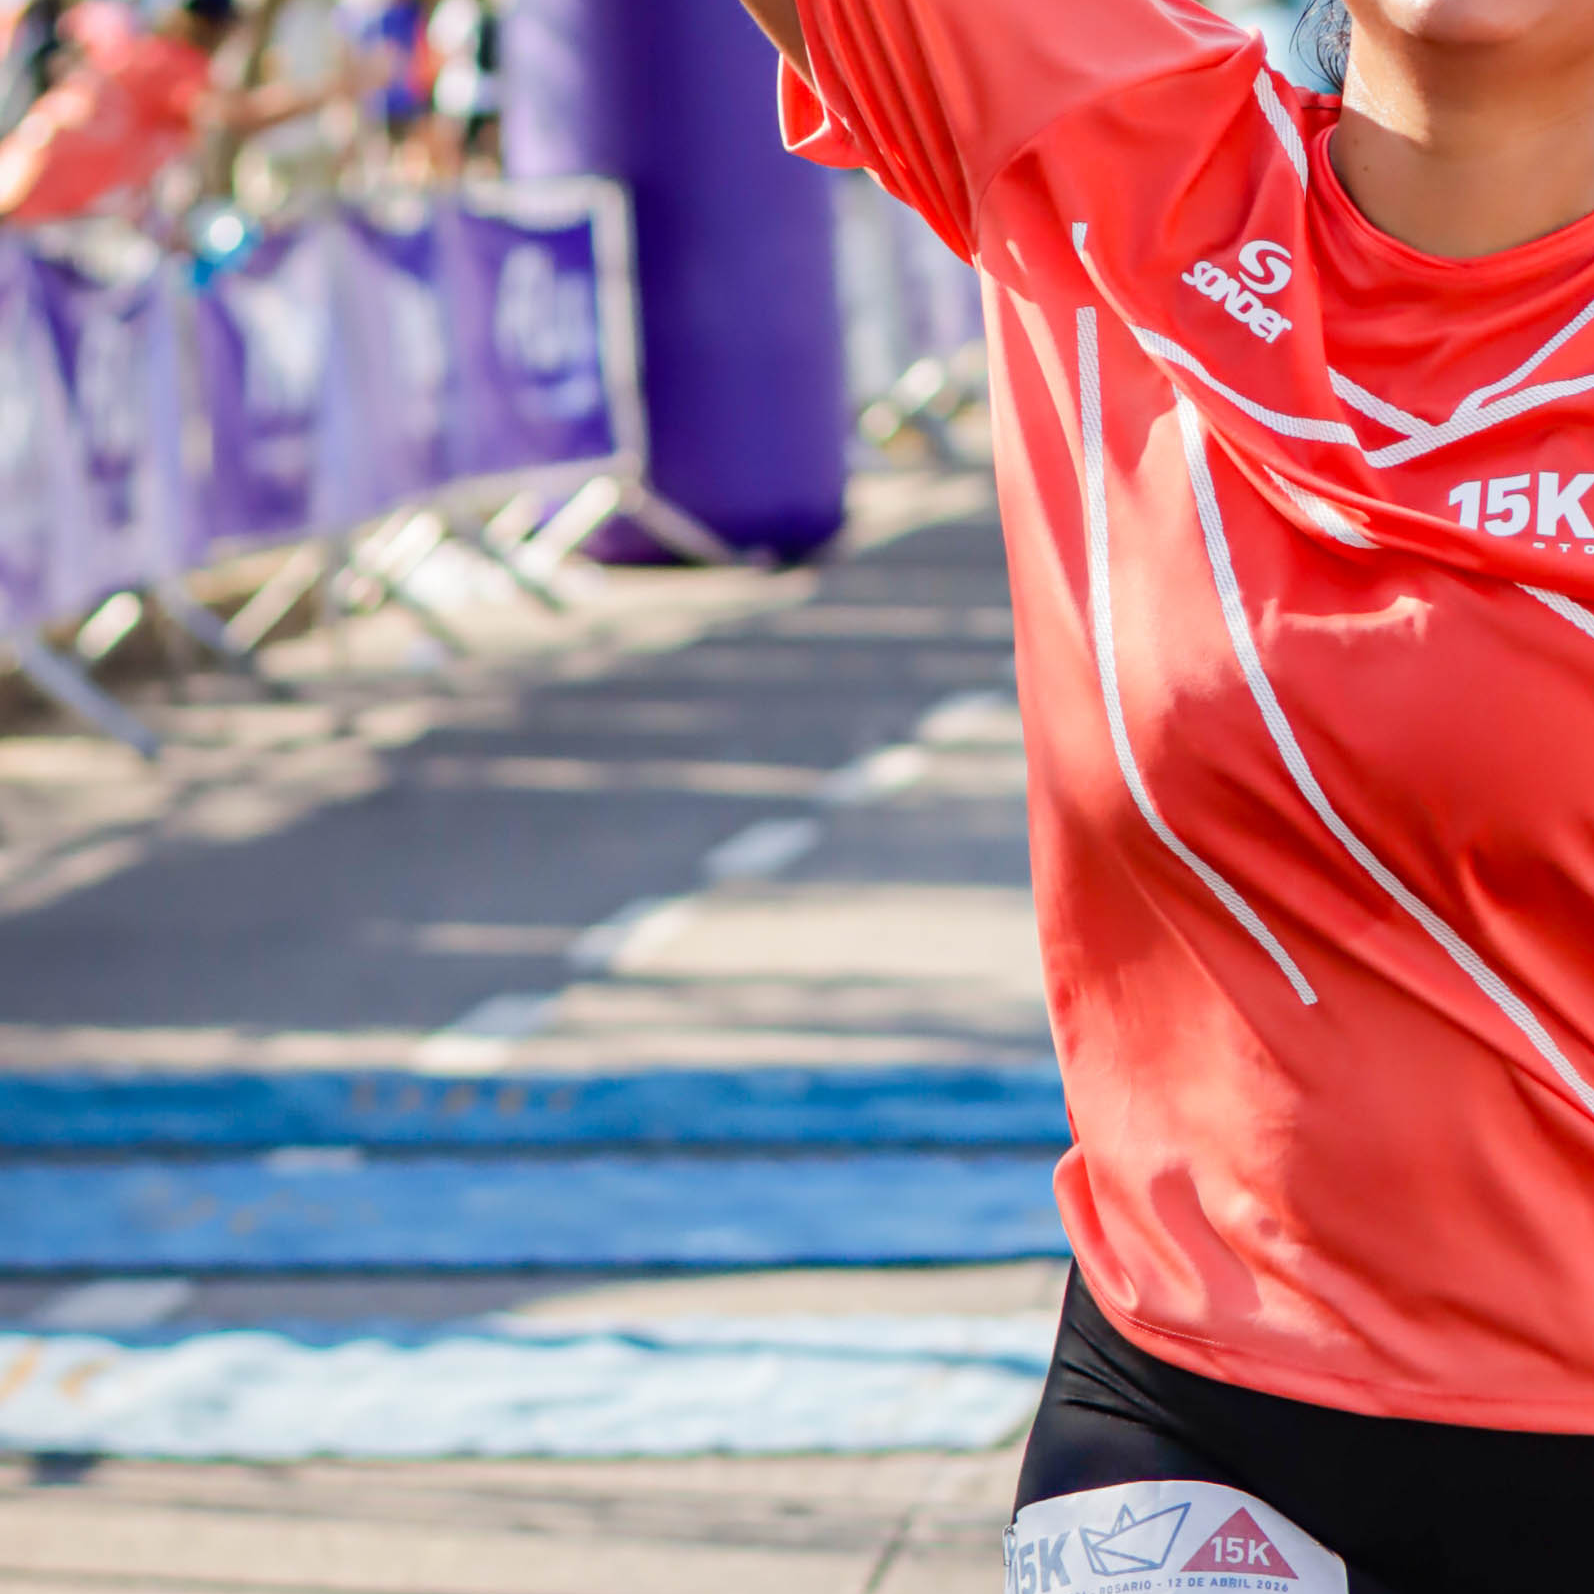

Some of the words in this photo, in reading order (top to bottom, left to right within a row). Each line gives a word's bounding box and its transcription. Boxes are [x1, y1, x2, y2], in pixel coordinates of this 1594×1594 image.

[1211, 1536, 1272, 1567] 15K
[1168, 1578, 1181, 1588] 12
[1187, 1577, 1205, 1588] DE
[1210, 1577, 1251, 1589] ABRIL
[1256, 1579, 1290, 1593] 2026
